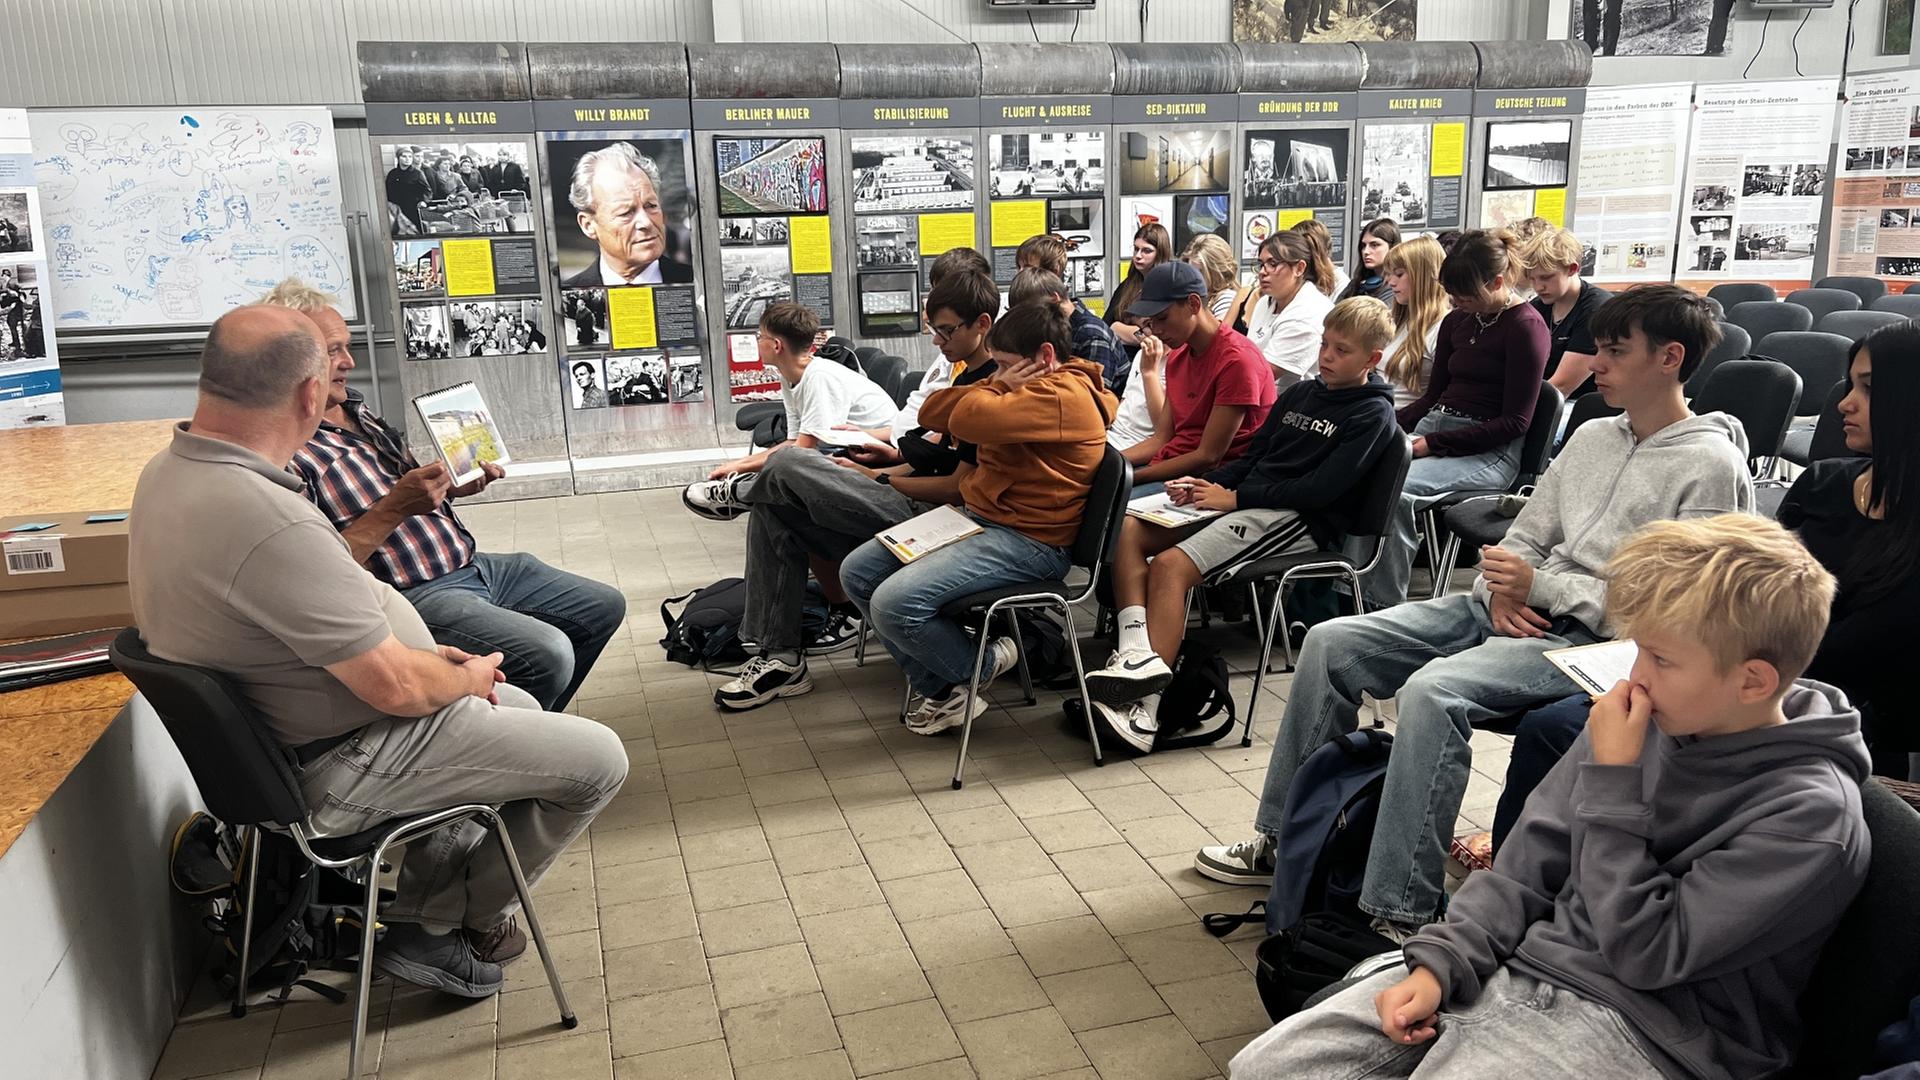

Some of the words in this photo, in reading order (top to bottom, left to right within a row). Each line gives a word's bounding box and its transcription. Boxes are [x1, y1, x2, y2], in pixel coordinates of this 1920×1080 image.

[1145, 103, 1206, 115] SED-DIKTATUR
[1258, 100, 1303, 113] GRÜNDUNG
[1304, 101, 1320, 113] DER
[1322, 101, 1339, 113] DDR
[1389, 98, 1417, 110] KALTER
[1419, 97, 1443, 109] KRIEG
[1495, 97, 1534, 109] DEUTSCHE
[1536, 96, 1567, 108] TEILUNG
[574, 109, 606, 121] WILLY
[609, 108, 650, 121] BRANDT
[725, 108, 774, 121] BERLINER
[776, 107, 810, 120] MAUER
[873, 107, 949, 120] STABILISIERUNG
[1002, 106, 1036, 118] FLUCHT
[1039, 105, 1047, 117] &
[1049, 104, 1092, 117] AUSREISE
[404, 112, 440, 125] LEBEN
[444, 112, 454, 125] &
[458, 111, 497, 124] ALLTAG
